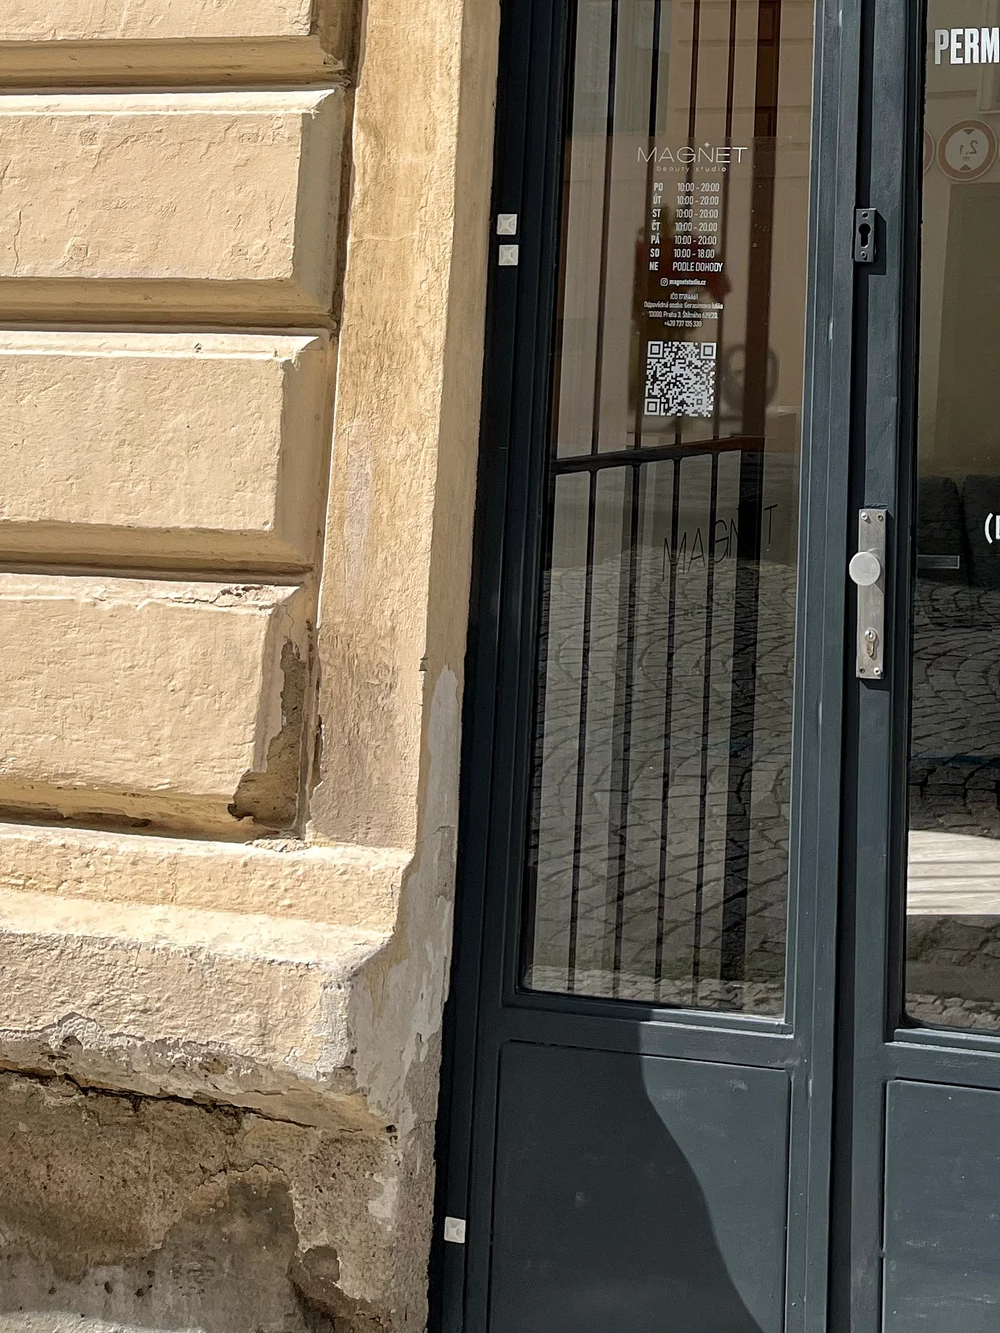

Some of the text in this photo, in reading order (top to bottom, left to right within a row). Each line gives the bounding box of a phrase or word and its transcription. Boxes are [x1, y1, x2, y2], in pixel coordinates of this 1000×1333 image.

[638, 145, 748, 163] MAGNET
[653, 182, 664, 192] PO
[652, 193, 662, 205] ÚT
[652, 208, 661, 218] ST
[651, 219, 661, 231] ČT
[650, 233, 660, 245] PÁ
[650, 248, 660, 258] SO
[649, 261, 724, 272] NE PODLE DOHODY
